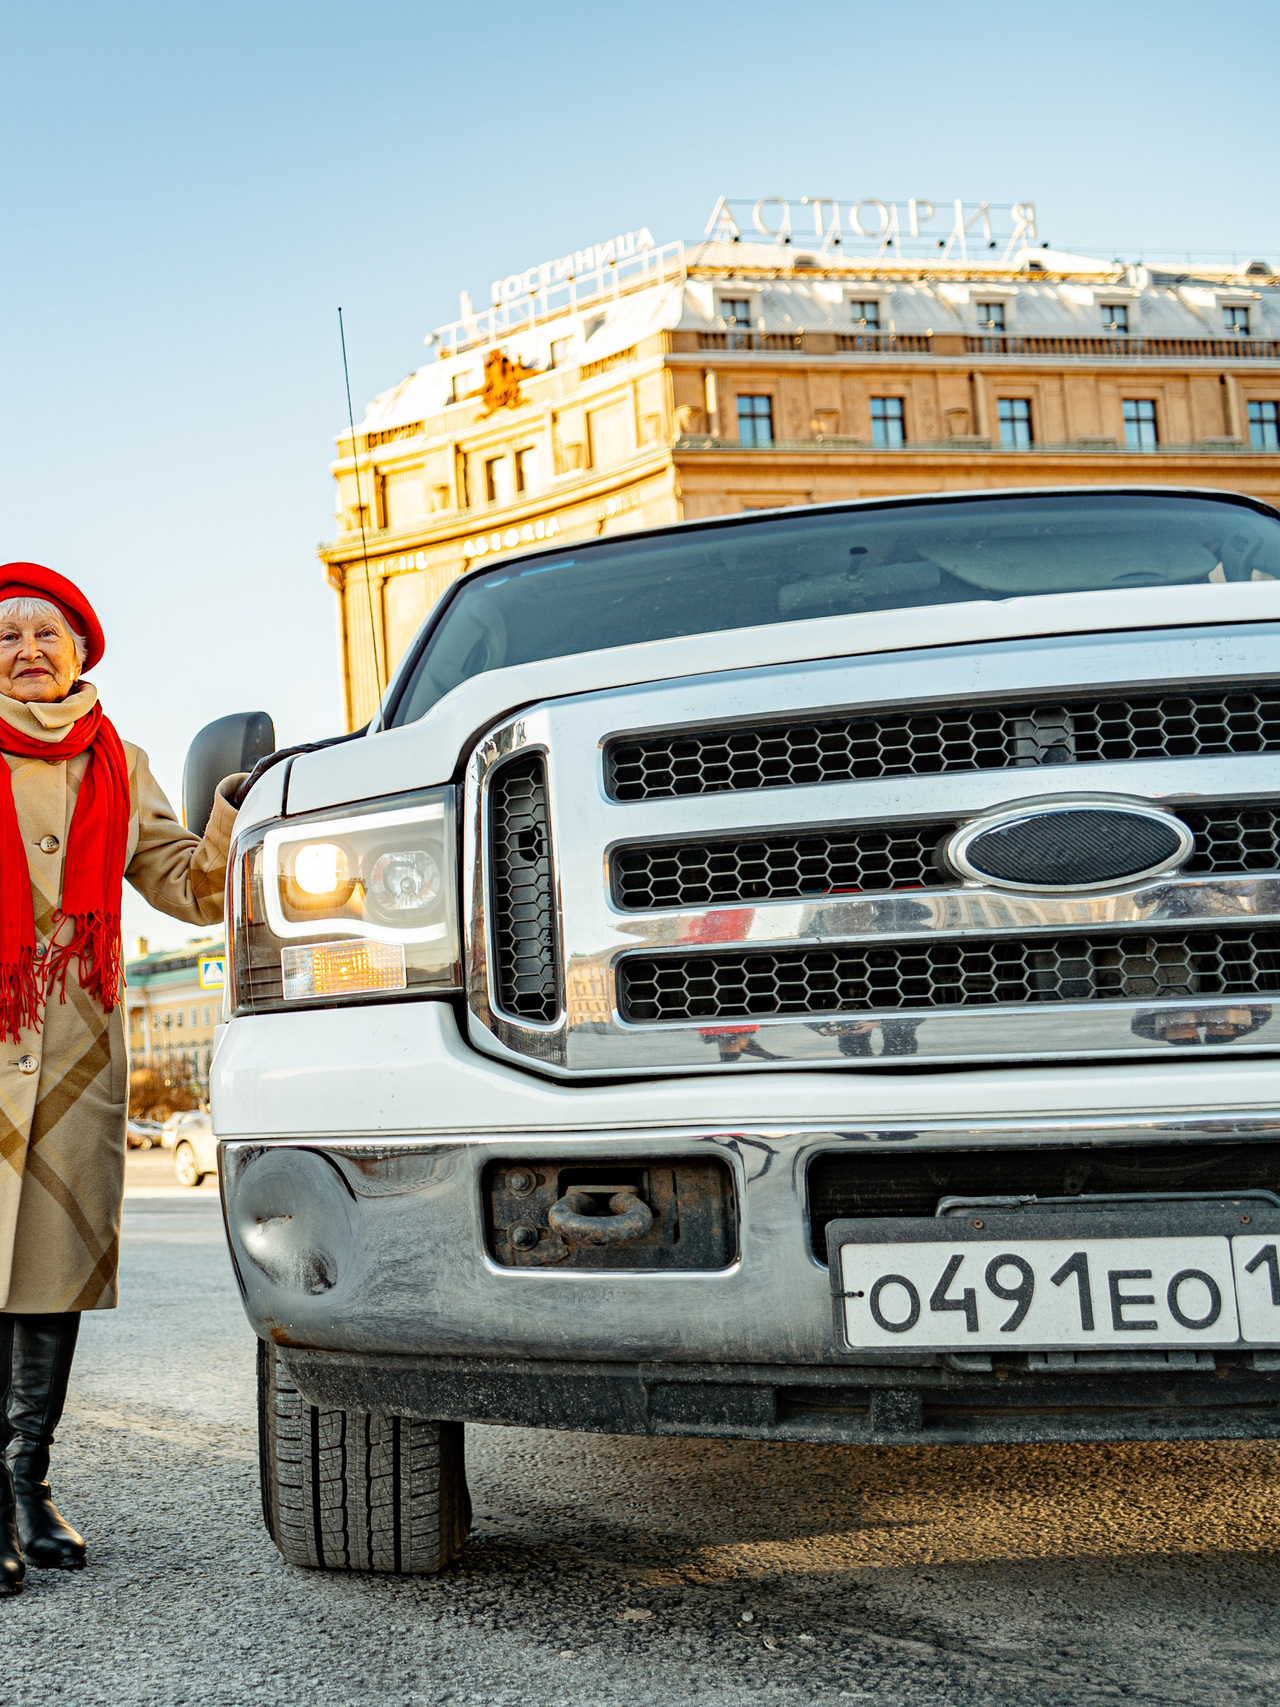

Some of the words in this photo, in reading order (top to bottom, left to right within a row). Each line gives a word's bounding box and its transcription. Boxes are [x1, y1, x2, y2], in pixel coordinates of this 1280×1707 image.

[703, 195, 1037, 239] АСТОРИЯ
[491, 226, 656, 304] ГОСТИНИЦА
[463, 516, 561, 557] ASTORIA
